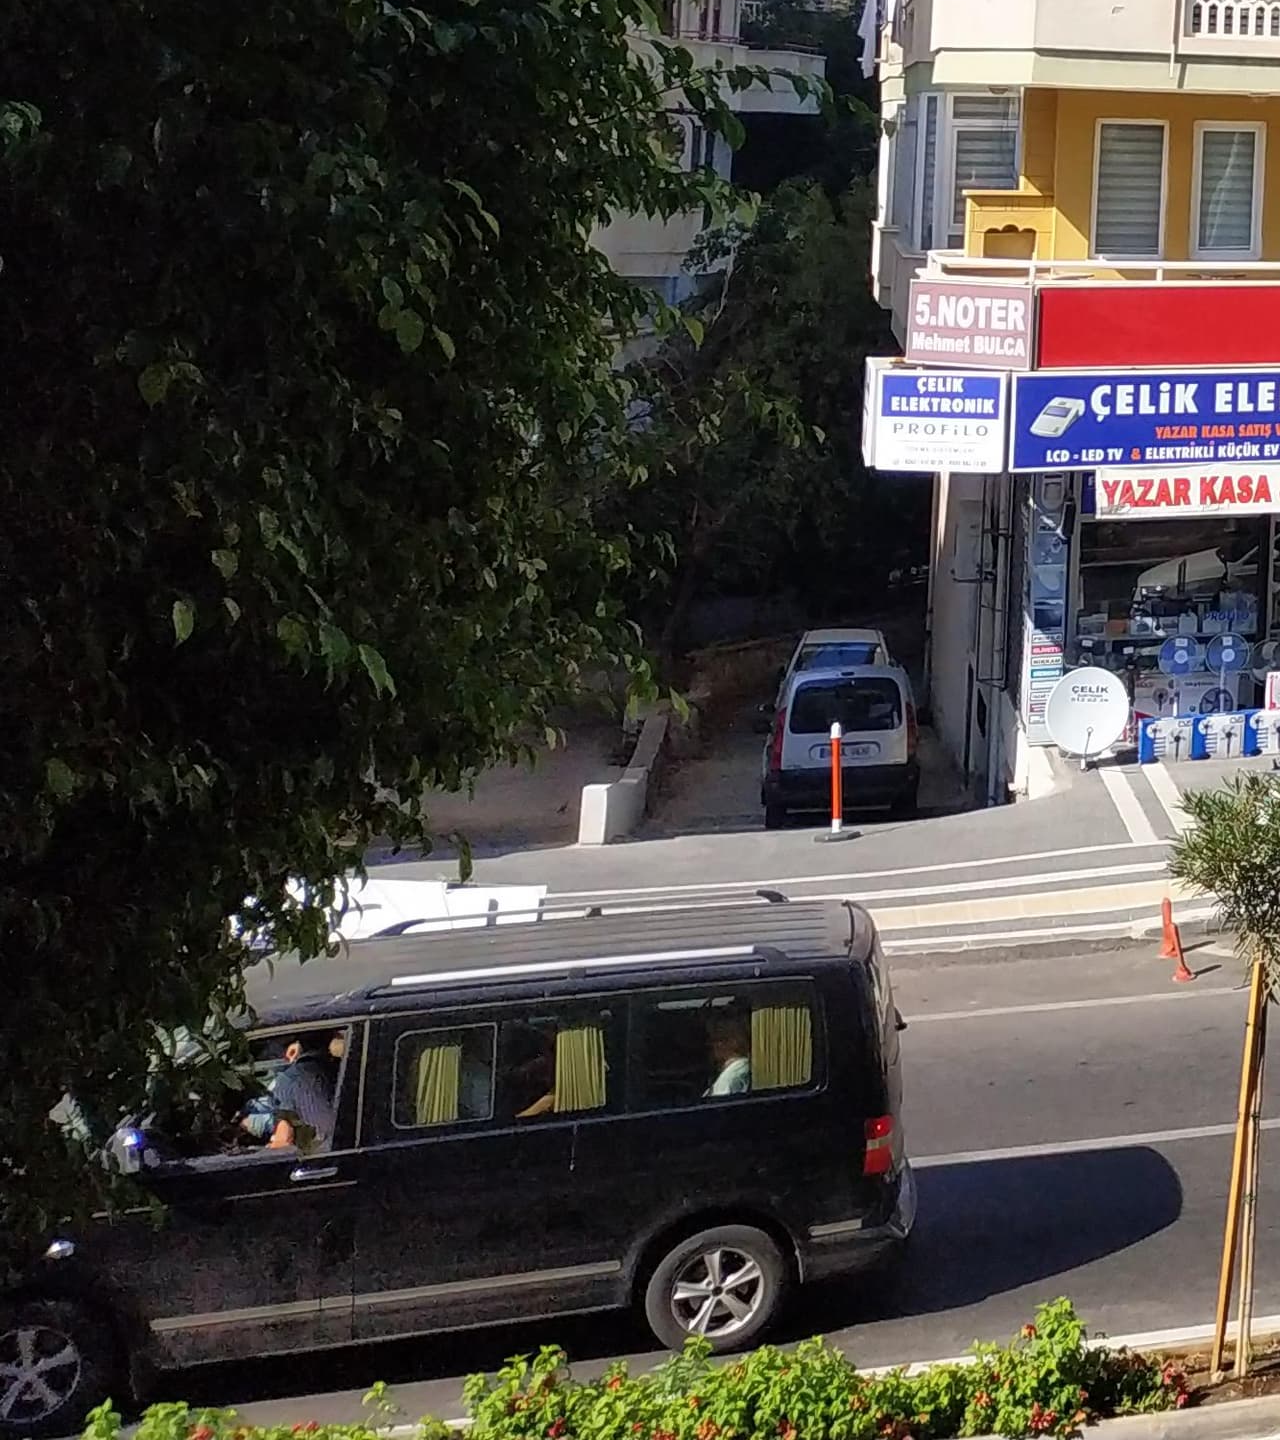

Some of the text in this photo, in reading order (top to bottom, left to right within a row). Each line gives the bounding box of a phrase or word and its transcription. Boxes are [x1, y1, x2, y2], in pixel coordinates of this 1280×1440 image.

[914, 293, 1026, 332] 5.NOTER
[911, 331, 1026, 358] Mehmet BULCA
[1155, 425, 1198, 440] YAZAR
[1201, 424, 1236, 439] KASA
[1238, 422, 1272, 439] SATIŞ
[1045, 449, 1070, 463] LCD
[1081, 448, 1105, 462] LED
[1107, 447, 1124, 461] TV
[1130, 448, 1141, 461] &
[1145, 440, 1215, 460] ELEKTRİKLİ
[1217, 441, 1261, 460] KÜÇÜK
[1263, 443, 1280, 457] EV
[1101, 476, 1192, 508] YAZAR
[1200, 475, 1273, 506] KASA
